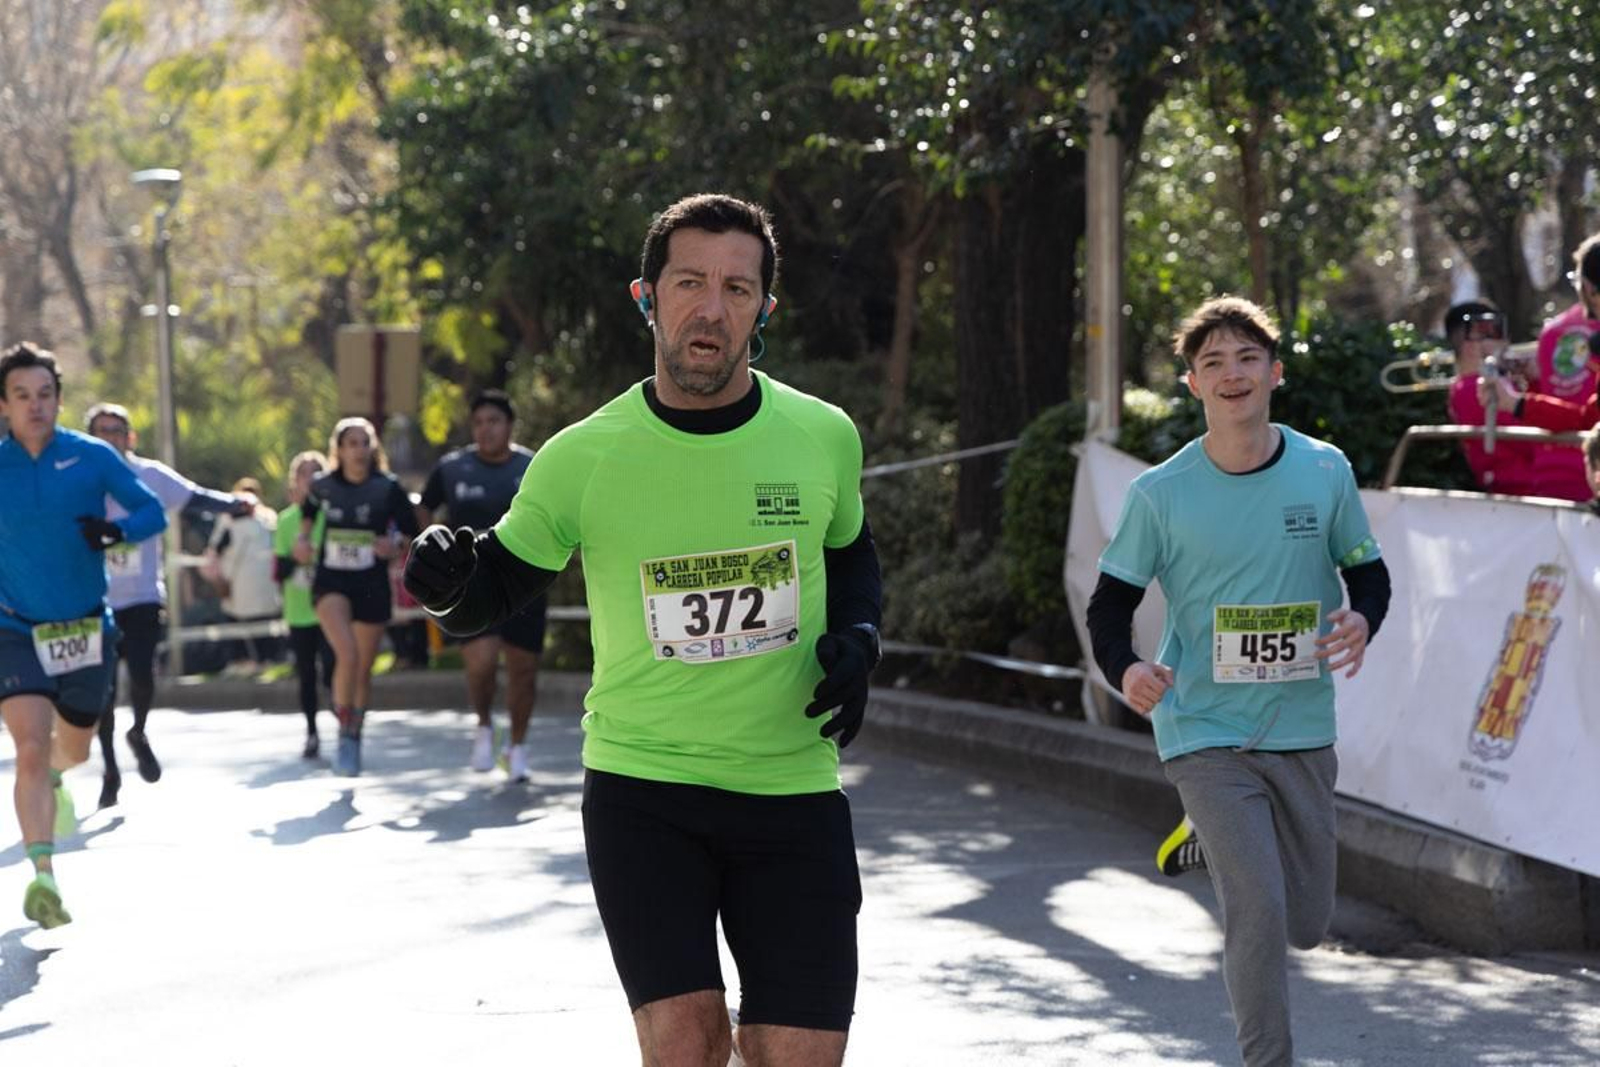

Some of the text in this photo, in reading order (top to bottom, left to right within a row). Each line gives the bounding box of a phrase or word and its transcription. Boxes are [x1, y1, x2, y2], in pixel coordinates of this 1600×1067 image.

[671, 559, 689, 574] SAN
[693, 556, 718, 571] JUAN
[721, 554, 749, 568] BOSCO
[667, 572, 705, 588] CARRERA
[706, 568, 743, 586] POPULAR
[682, 586, 767, 638] 372
[49, 635, 89, 660] 1200
[1240, 631, 1297, 663] 455
